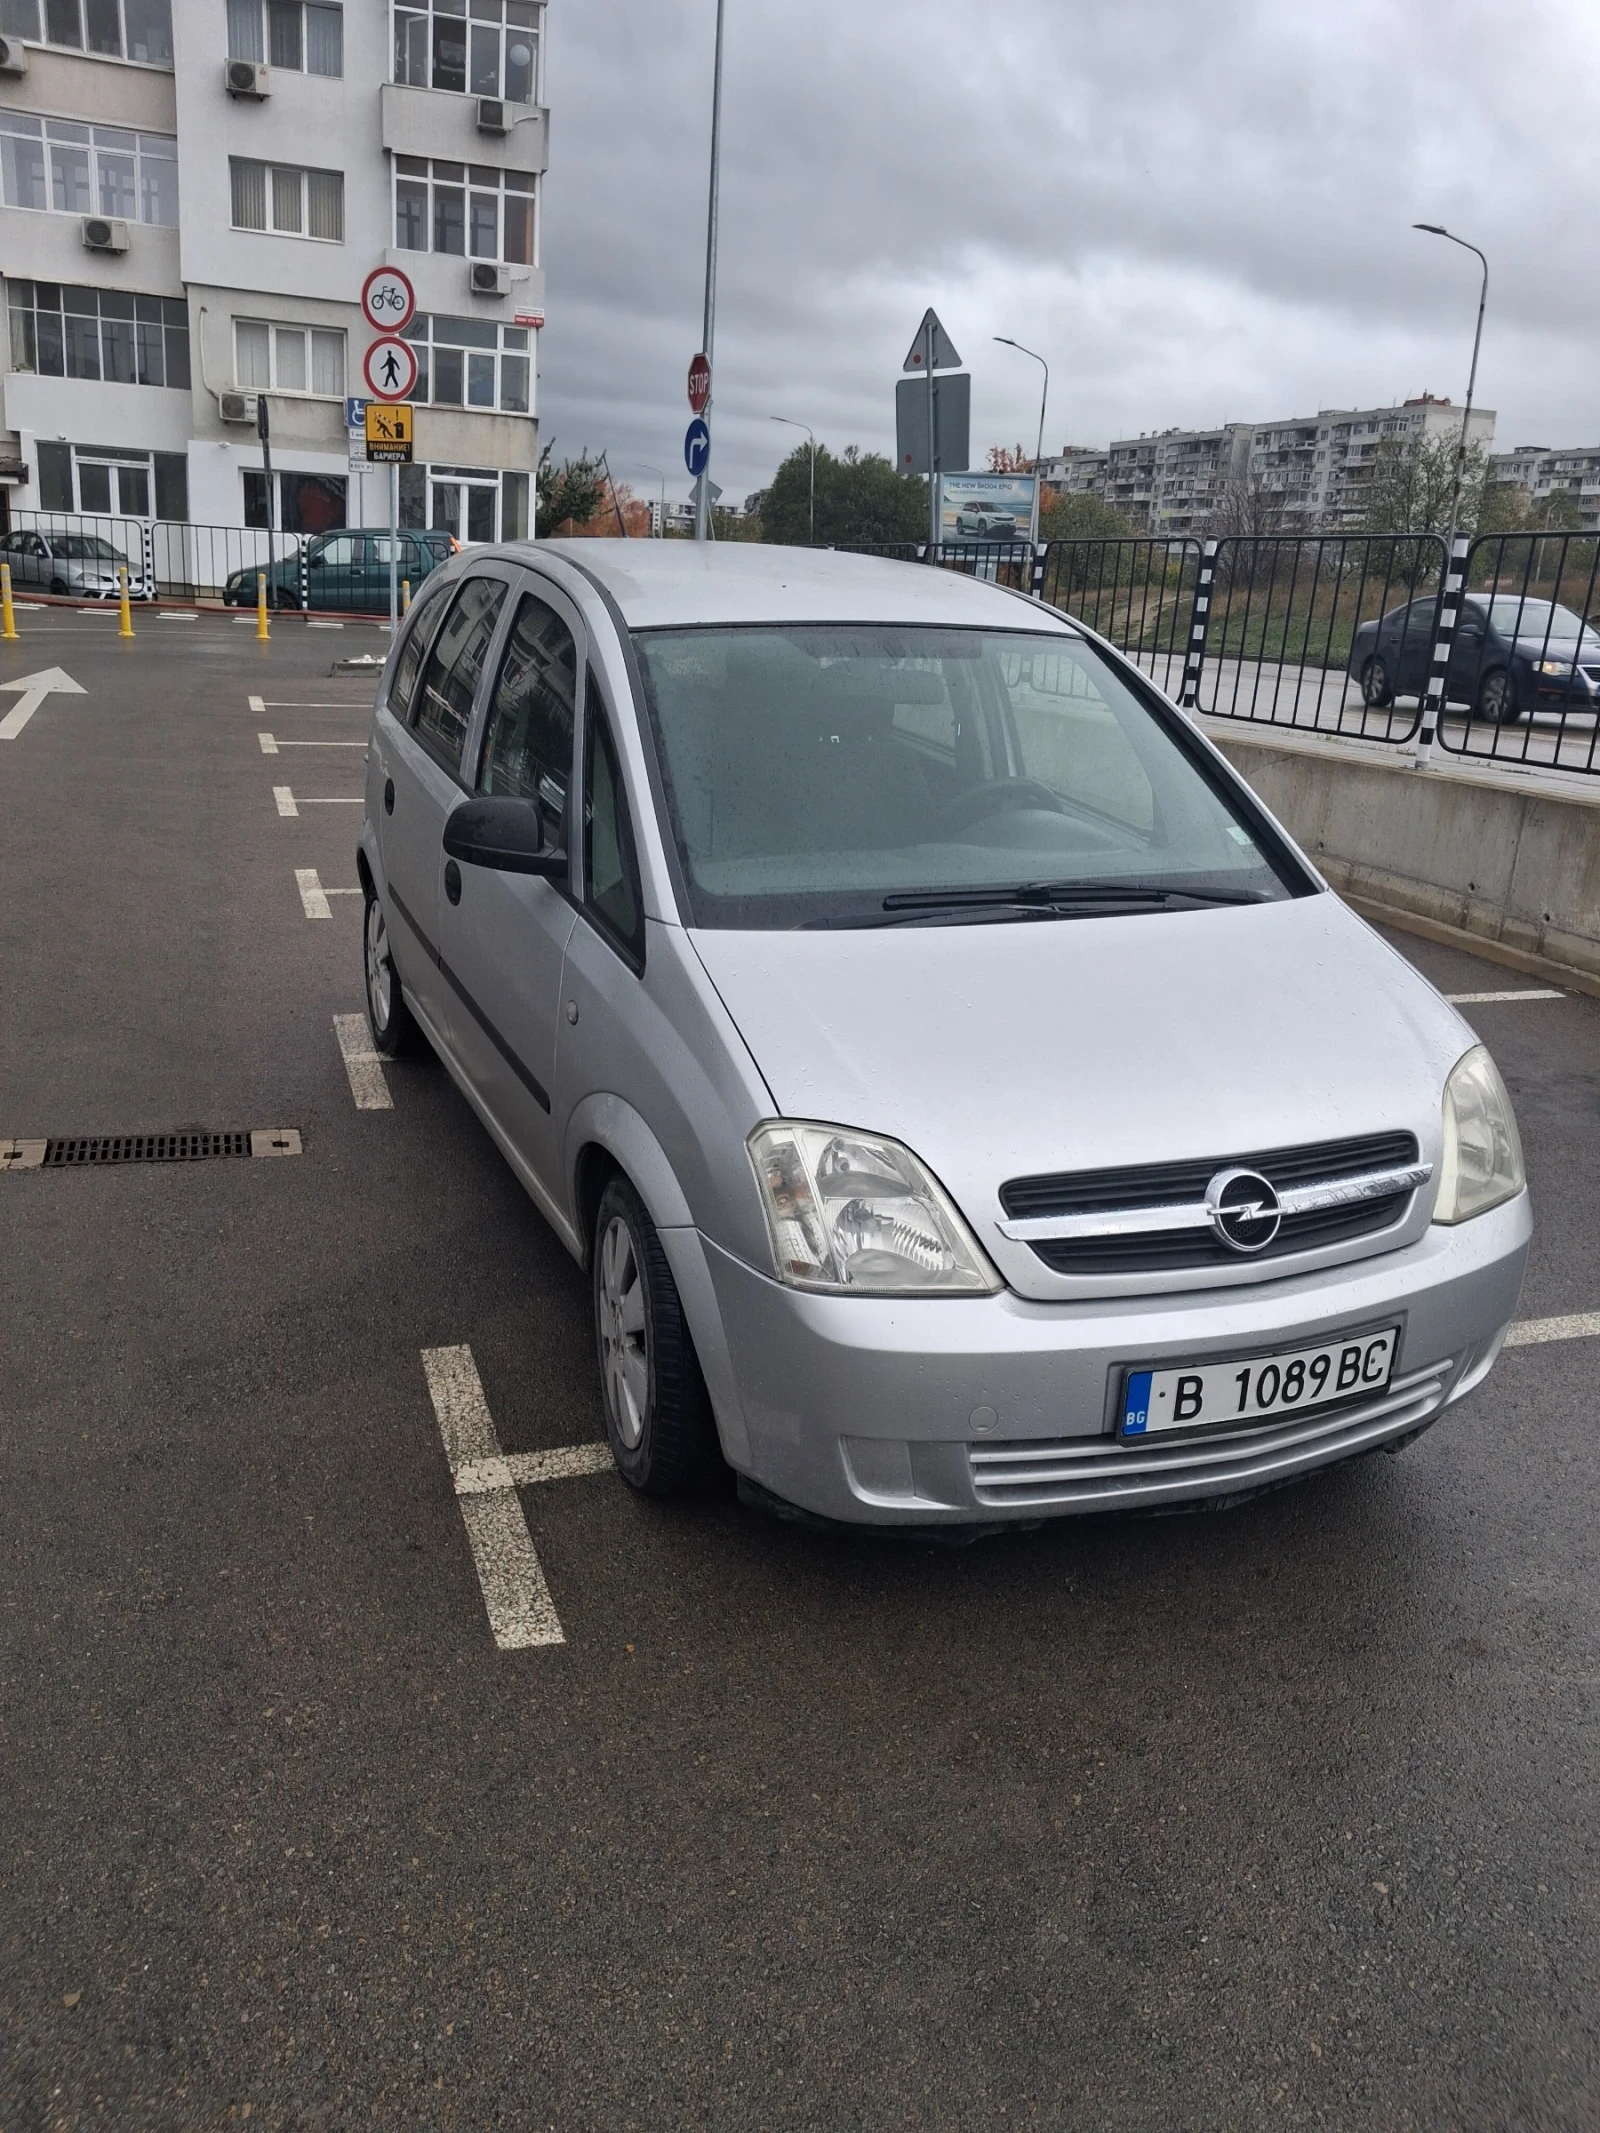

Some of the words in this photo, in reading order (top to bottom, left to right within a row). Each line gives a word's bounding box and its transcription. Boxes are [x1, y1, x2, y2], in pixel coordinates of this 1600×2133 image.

[690, 372, 709, 395] STOP
[369, 442, 410, 452] ВНИМАНИЕ!
[373, 452, 406, 461] БАРИЕРА
[1172, 1375, 1204, 1422] B
[1235, 1354, 1331, 1412] 1089
[1335, 1339, 1388, 1391] BC
[1126, 1411, 1146, 1426] BG
